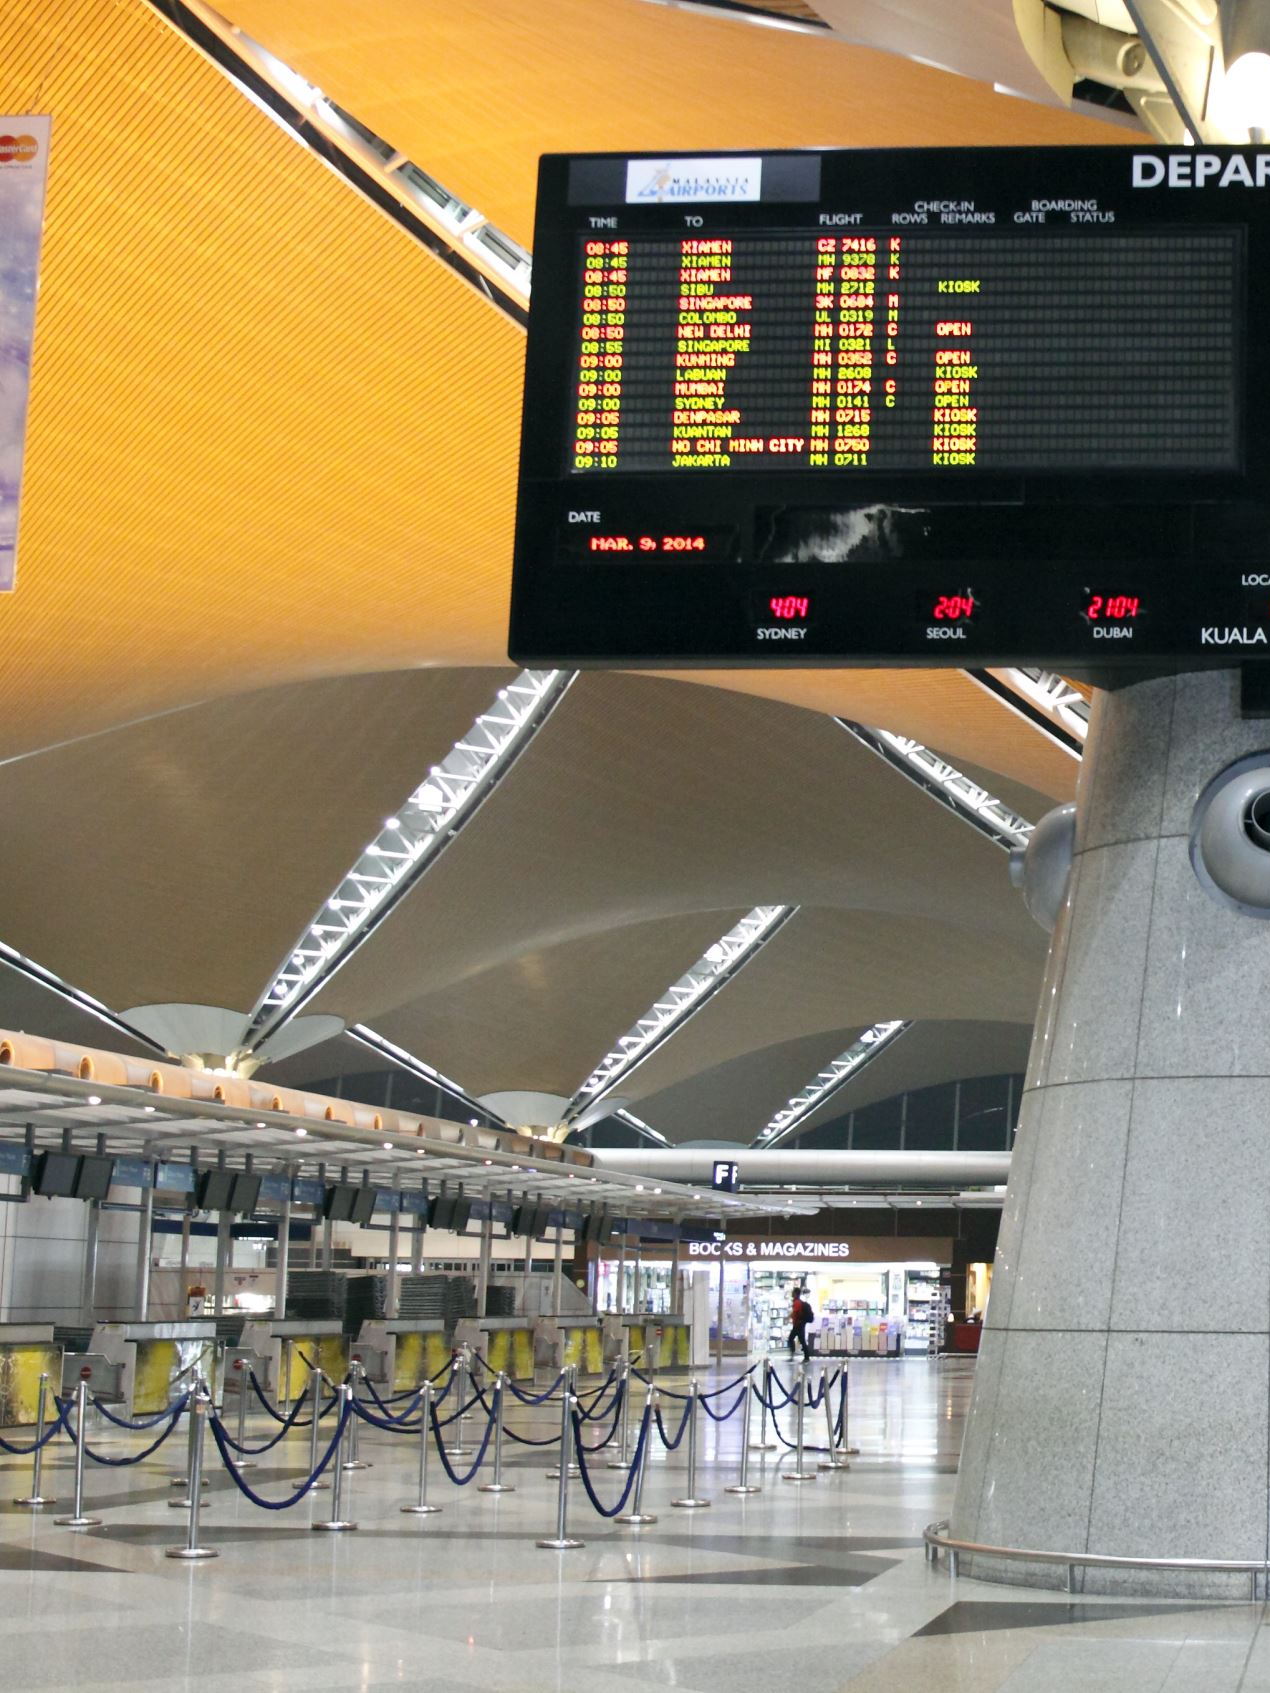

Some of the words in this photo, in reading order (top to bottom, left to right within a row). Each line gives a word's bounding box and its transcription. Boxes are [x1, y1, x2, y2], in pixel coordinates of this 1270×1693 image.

[667, 184, 748, 196] AIRPORTS
[915, 201, 974, 212] CHECK-IN
[1032, 200, 1097, 211] BOARDING
[590, 217, 616, 228] TIME
[685, 216, 703, 227] TO
[820, 214, 862, 225] FLIGHT
[892, 213, 928, 224] ROWS
[941, 213, 995, 223] REMARKS
[1014, 213, 1046, 223] GATE
[1068, 213, 1114, 222] STATUS
[585, 241, 628, 255] 08:45
[681, 239, 732, 253] XIAMEN
[587, 256, 626, 269] 08:45
[682, 254, 731, 267] XIAMEN
[584, 270, 627, 284] 08:45
[679, 268, 731, 282] XIAMEN
[585, 285, 626, 297] 08:50
[681, 283, 713, 296] SIBU
[939, 281, 980, 293] KIOSK
[582, 298, 625, 312] 08:50
[678, 297, 752, 311] SINGAPORE
[583, 313, 624, 326] 08:50
[679, 312, 736, 324] COLOMBO
[580, 327, 624, 341] 08:50
[676, 325, 704, 339] NEW
[708, 325, 751, 339] DELHI
[935, 323, 971, 337] OPEN
[582, 342, 622, 354] 08:55
[678, 340, 749, 353] SINGAPORE
[579, 355, 623, 369] 09:00
[674, 354, 735, 368] KUNMING
[934, 351, 970, 365] OPEN
[580, 370, 621, 383] 09:00
[676, 369, 726, 381] LABUAN
[936, 366, 977, 379] KIOSK
[578, 384, 621, 398] 09:00
[673, 382, 724, 396] MUMBAI
[934, 380, 970, 394] OPEN
[578, 399, 620, 412] 09:00
[675, 397, 724, 410] SYDNEY
[935, 395, 969, 408] OPEN
[576, 413, 619, 427] 09:05
[672, 411, 740, 425] DENPASAR
[932, 409, 976, 423] KIOSK
[577, 428, 618, 440] 09:05
[674, 426, 731, 439] KUANTAN
[934, 424, 976, 436] KIOSK
[574, 441, 617, 455] 09:05
[670, 440, 690, 454] HO
[694, 440, 721, 454] CHI
[729, 439, 765, 453] MINH
[768, 439, 805, 453] CITY
[932, 437, 976, 451] KIOSK
[575, 456, 617, 469] 09:10
[672, 455, 730, 467] JAKARTA
[933, 452, 975, 465] KIOSK
[569, 512, 600, 522] DATE
[590, 537, 633, 551] MAR.
[639, 537, 656, 550] 9,
[662, 537, 705, 550] 2014
[757, 628, 806, 639] SYDNEY
[927, 628, 966, 638] SEOUL
[1094, 627, 1132, 638] DUBAI
[1202, 628, 1267, 644] KUALA
[715, 1165, 729, 1184] F
[747, 1243, 757, 1255] &
[760, 1242, 849, 1256] MAGAZINES
